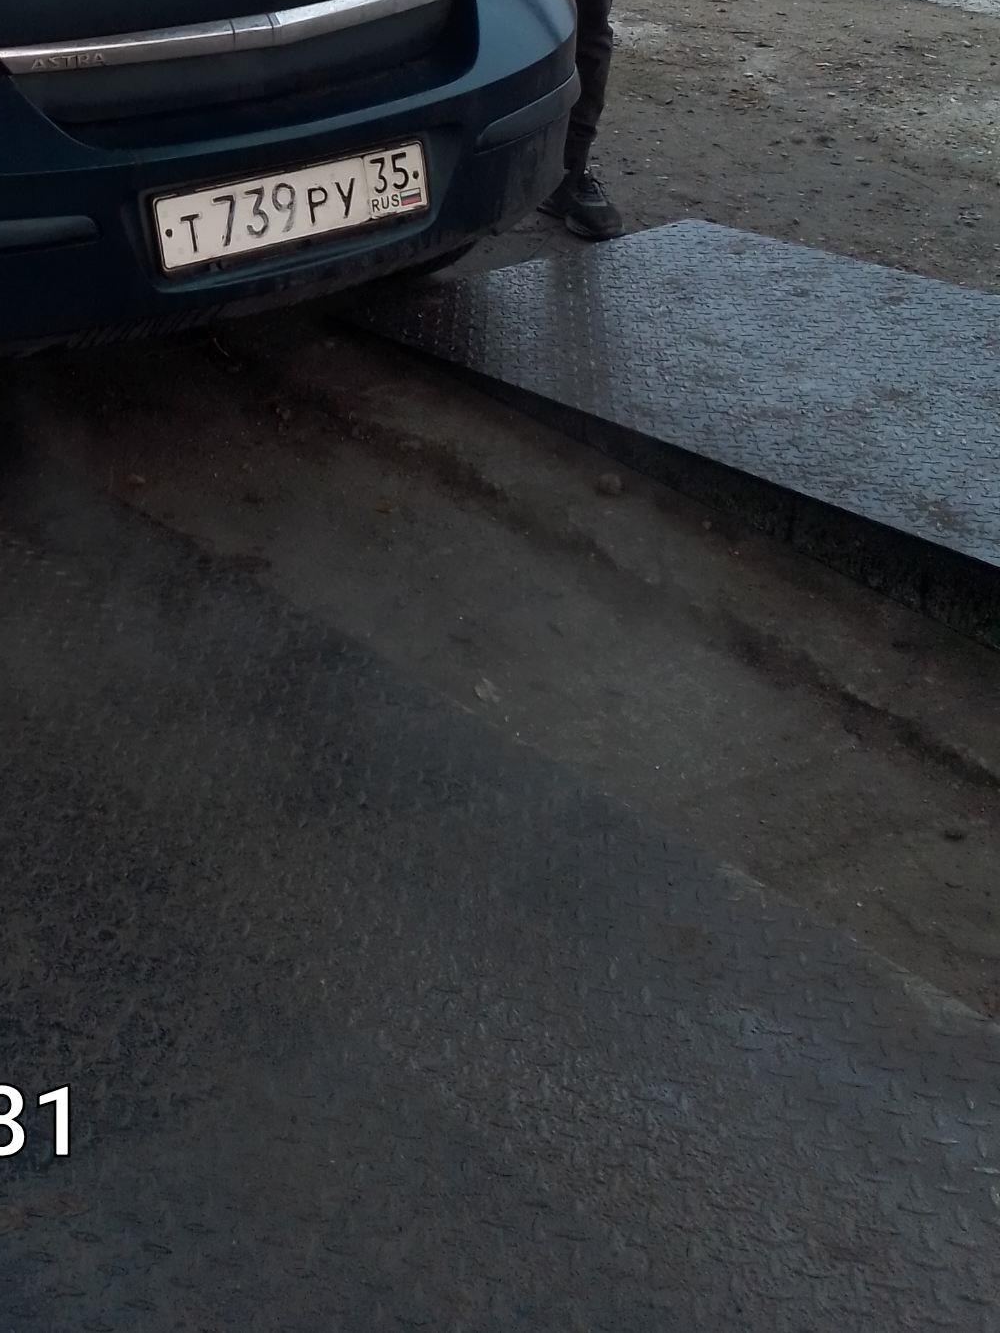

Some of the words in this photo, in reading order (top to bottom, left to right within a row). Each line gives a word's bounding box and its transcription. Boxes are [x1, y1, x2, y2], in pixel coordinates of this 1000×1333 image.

[31, 52, 105, 69] ASTRA
[369, 152, 410, 194] 35
[371, 193, 400, 213] RUS
